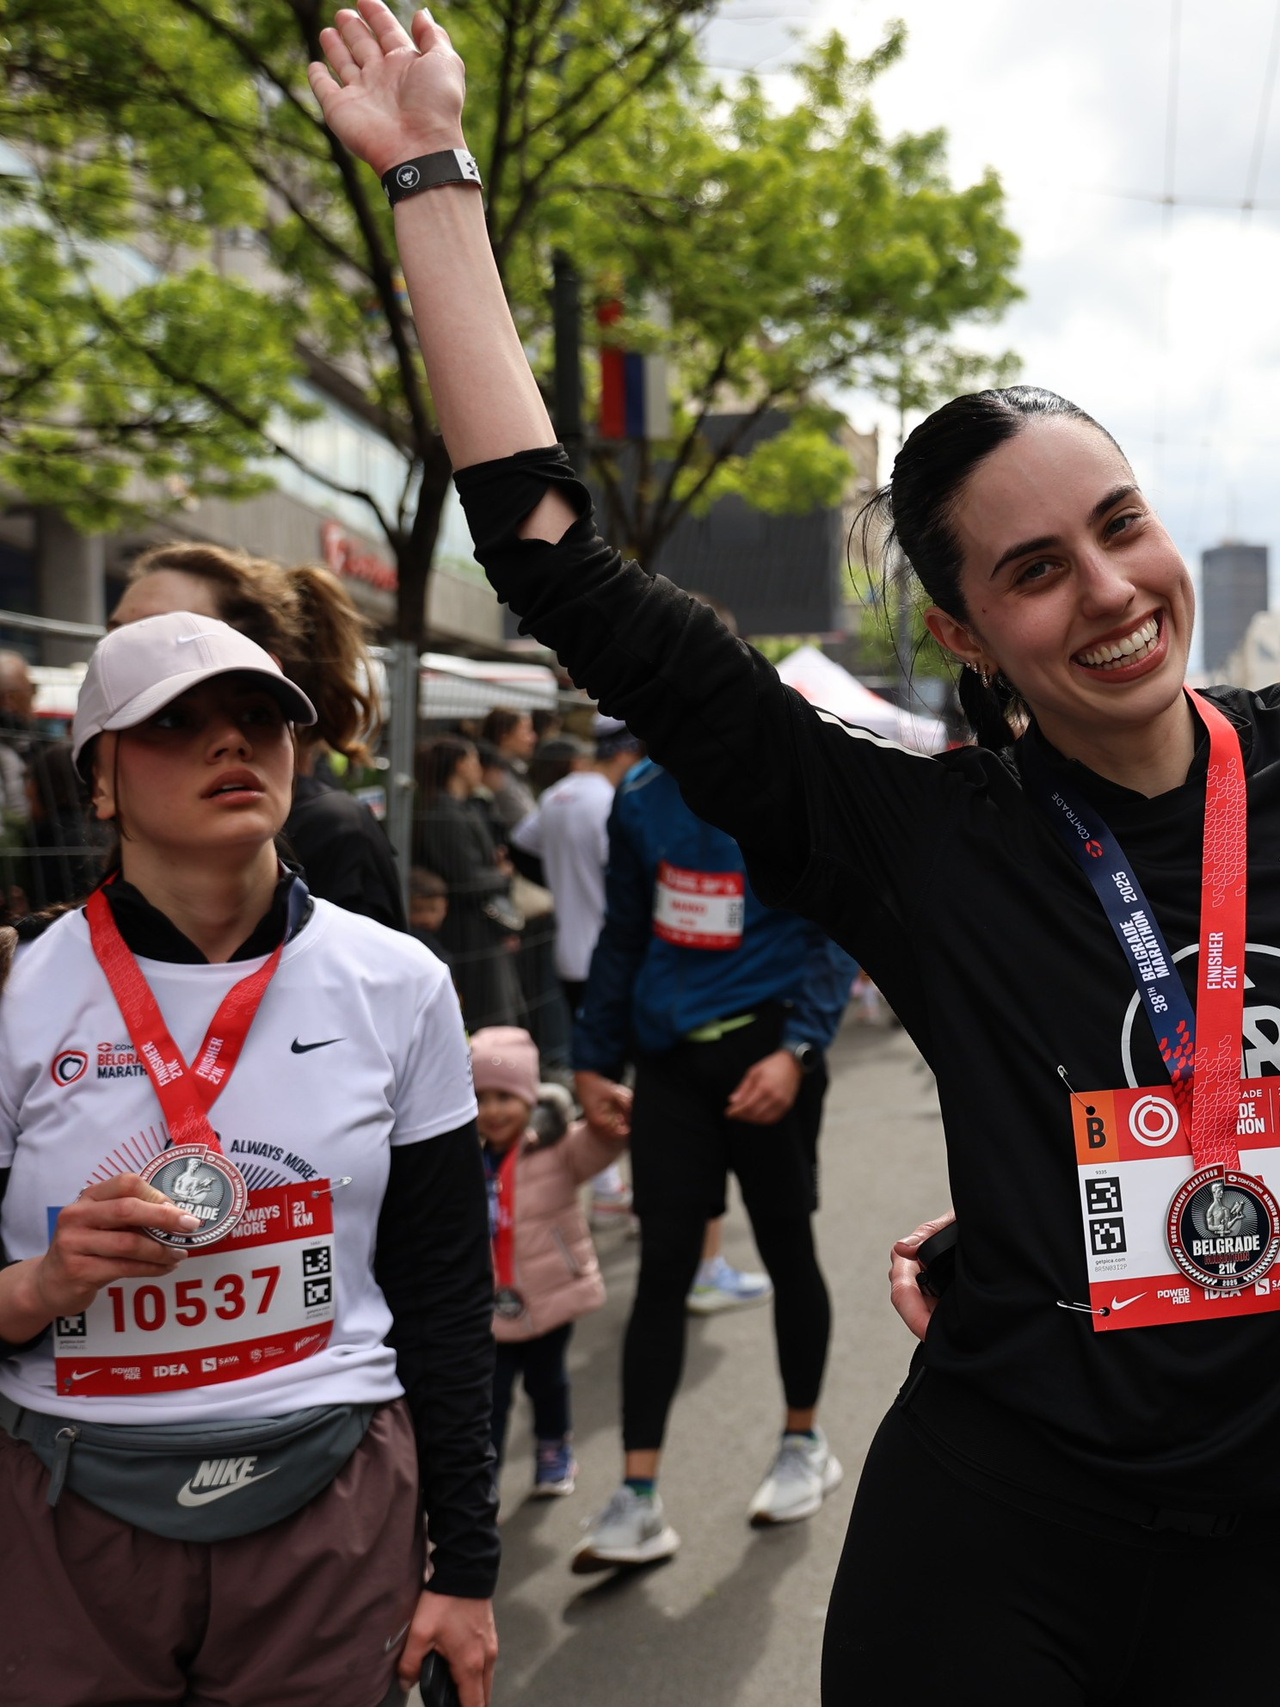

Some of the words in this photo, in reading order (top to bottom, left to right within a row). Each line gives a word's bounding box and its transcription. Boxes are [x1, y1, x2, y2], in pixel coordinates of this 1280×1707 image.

[1051, 792, 1091, 841] COMTRADE
[1112, 871, 1137, 903] 2025
[1119, 919, 1157, 982] BELGRADE
[1131, 910, 1171, 978] MARATHON
[1206, 931, 1224, 990] FINISHER
[1223, 964, 1237, 990] 21K
[1147, 986, 1170, 1014] 38TH
[97, 1053, 141, 1066] BELGR
[142, 1041, 171, 1087] FINISHER
[195, 1037, 224, 1078] FINISHER
[97, 1065, 147, 1079] MARATH
[167, 1059, 184, 1080] 21K
[207, 1066, 226, 1085] 21K
[1086, 1117, 1106, 1149] B
[230, 1139, 284, 1161] ALWAYS
[282, 1153, 318, 1181] MORE
[176, 1200, 220, 1222] GRADE
[292, 1201, 306, 1214] 21
[231, 1221, 267, 1239] MORE
[292, 1212, 313, 1228] KM
[1192, 1234, 1260, 1256] BELGRADE
[1095, 1257, 1126, 1265] getpica.com
[1218, 1262, 1237, 1275] 21K
[108, 1265, 281, 1333] 10537
[1157, 1287, 1190, 1299] POWER
[1172, 1295, 1191, 1305] ADE
[218, 1356, 239, 1365] SAVA
[193, 1456, 259, 1488] NIKE
